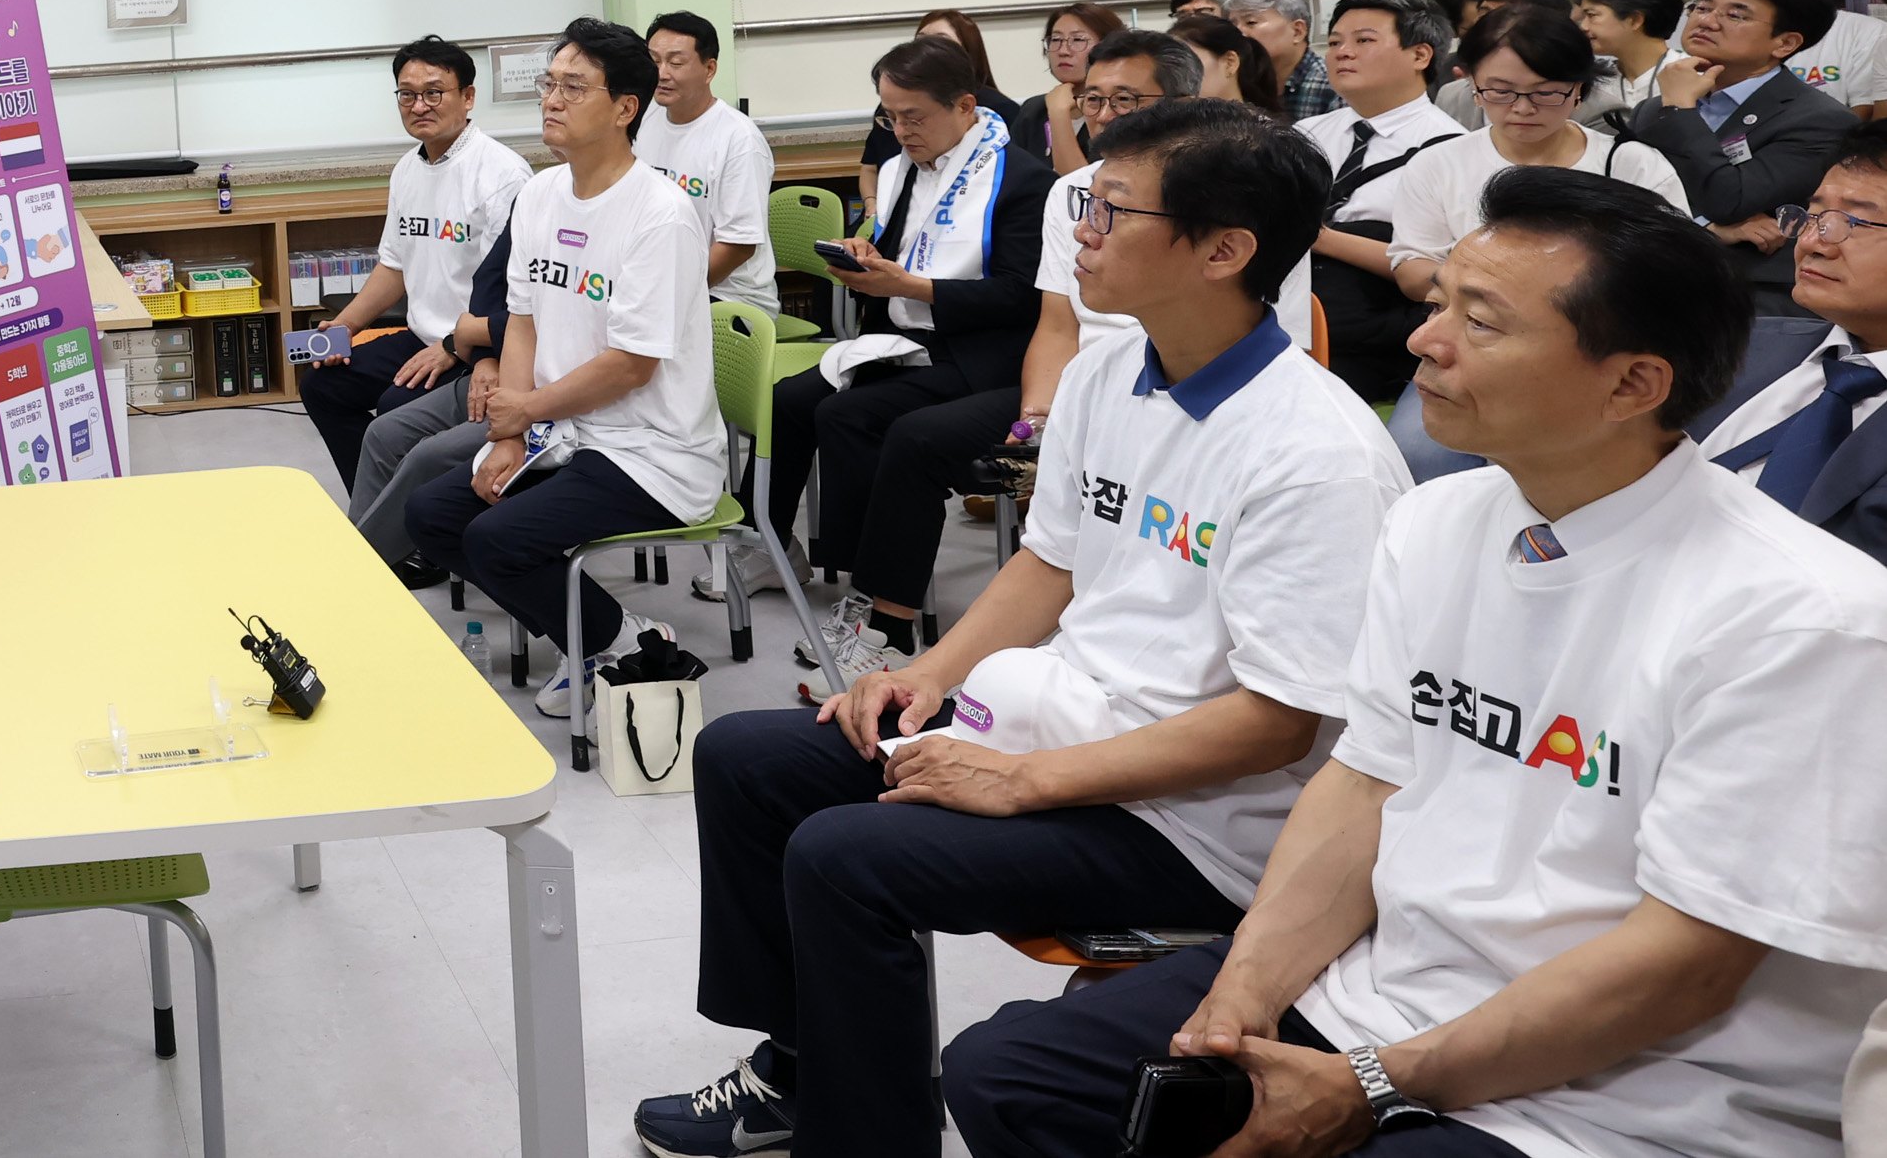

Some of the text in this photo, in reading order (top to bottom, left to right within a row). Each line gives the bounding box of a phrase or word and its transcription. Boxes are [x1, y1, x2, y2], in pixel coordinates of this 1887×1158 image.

[1791, 65, 1840, 82] RAS
[574, 266, 612, 303] AS!
[5, 296, 21, 307] 12월
[0, 326, 20, 342] 만드는
[20, 321, 37, 333] 3가지
[56, 340, 79, 357] 중학교
[7, 365, 28, 382] 5학년
[52, 353, 88, 374] 자율동아리
[1139, 494, 1217, 567] RAS
[1410, 670, 1620, 797] 손잡고 AS!
